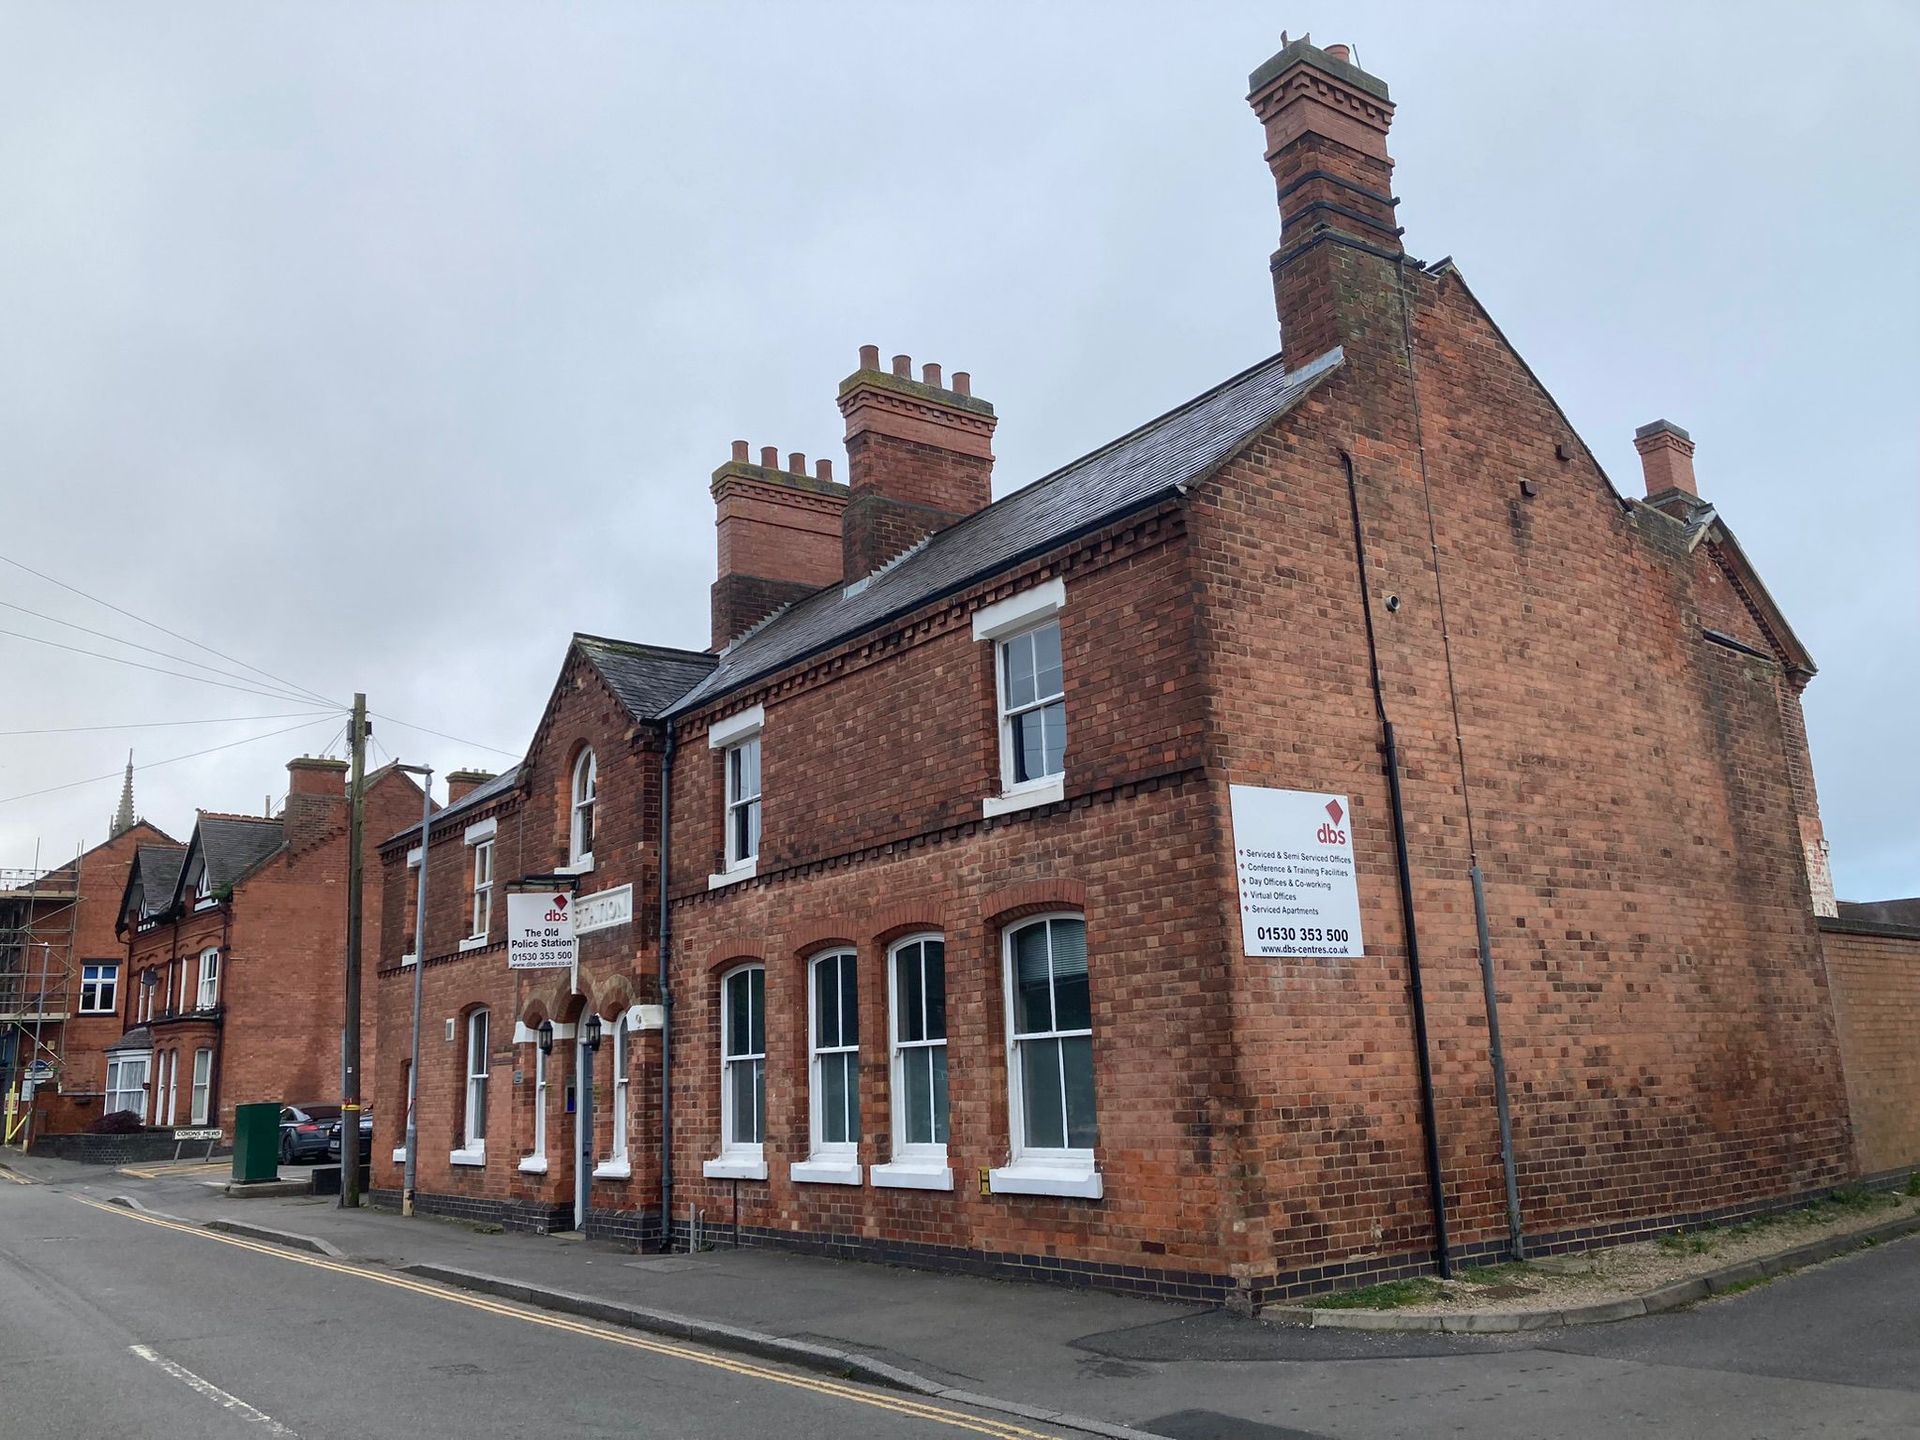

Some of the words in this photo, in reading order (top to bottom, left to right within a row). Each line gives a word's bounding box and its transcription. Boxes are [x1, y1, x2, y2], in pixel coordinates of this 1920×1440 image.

[1317, 823, 1346, 845] dbs
[1246, 849, 1275, 859] Serviced
[1283, 852, 1300, 860] Semi
[1300, 853, 1329, 862] Serviced
[1329, 855, 1352, 864] Offices
[1247, 863, 1286, 873] Conference
[1287, 865, 1292, 873] &
[1293, 866, 1319, 877] Training
[1320, 867, 1349, 877] Facilities
[1249, 877, 1262, 887] Day
[1263, 877, 1287, 887] Offices
[1288, 879, 1294, 887] &
[1295, 879, 1331, 890] Co-working
[1250, 890, 1272, 900] Virtual
[1273, 891, 1297, 901] Offices
[544, 909, 568, 922] dbs
[1251, 904, 1281, 914] Serviced
[1281, 906, 1319, 915] Apartments
[524, 928, 542, 937] The
[544, 928, 559, 937] Old
[1257, 927, 1296, 941] 01530
[1300, 928, 1323, 942] 353
[1326, 929, 1349, 942] 500
[511, 940, 539, 948] Police
[541, 938, 572, 947] Station
[1261, 944, 1349, 955] www.dbs-centres.co.uk
[512, 952, 537, 961] 01530
[539, 952, 555, 960] 353
[557, 951, 573, 960] 500
